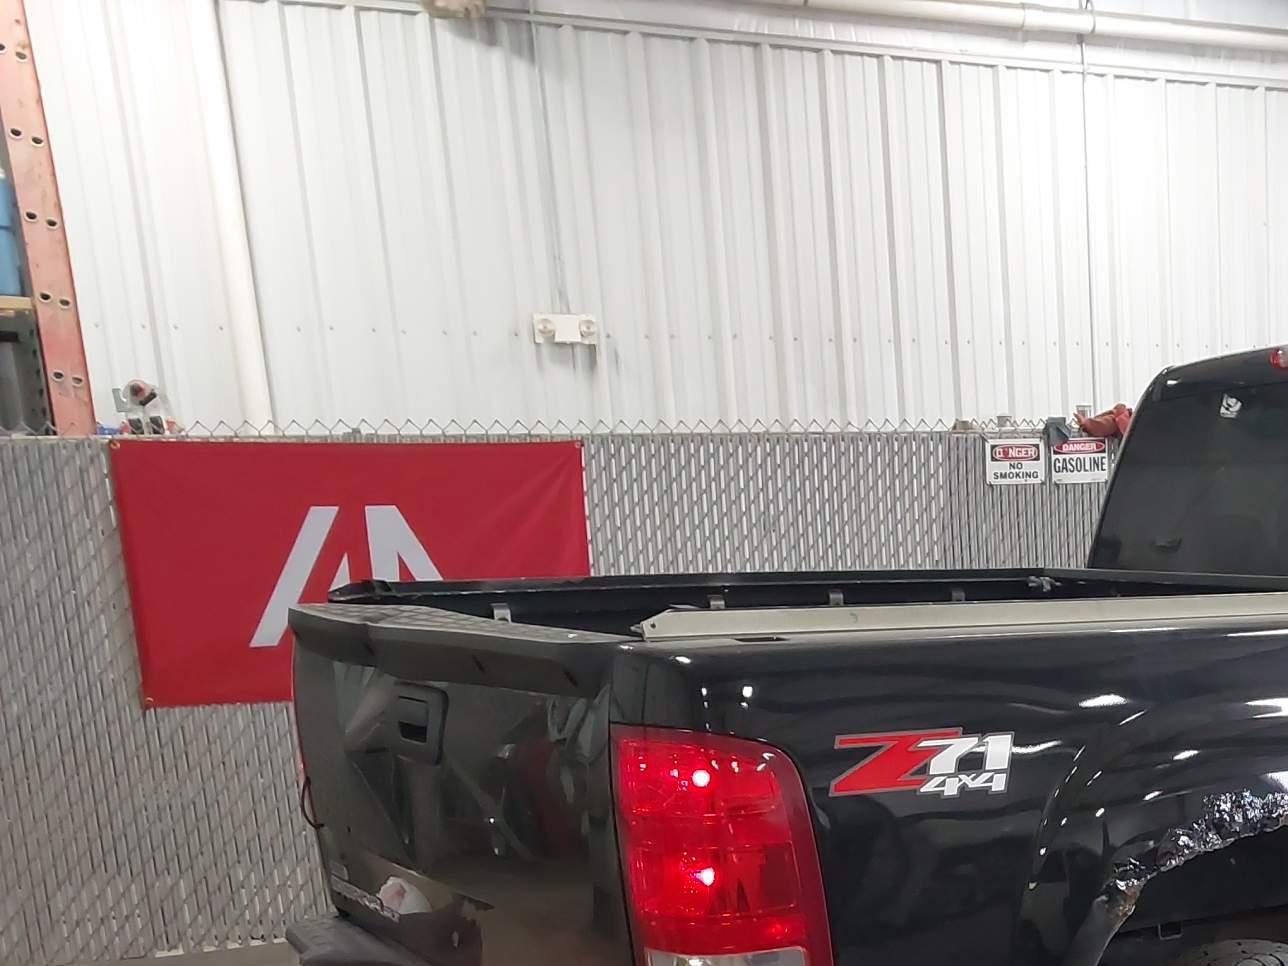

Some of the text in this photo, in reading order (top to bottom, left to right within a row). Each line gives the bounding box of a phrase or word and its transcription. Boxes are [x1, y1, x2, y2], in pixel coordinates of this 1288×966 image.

[996, 446, 1035, 458] DNGER
[1062, 442, 1097, 452] DANGER
[1009, 462, 1023, 470] NO
[1053, 456, 1107, 474] GASOLINE
[993, 471, 1039, 480] SMOKING
[829, 727, 1015, 797] Z71
